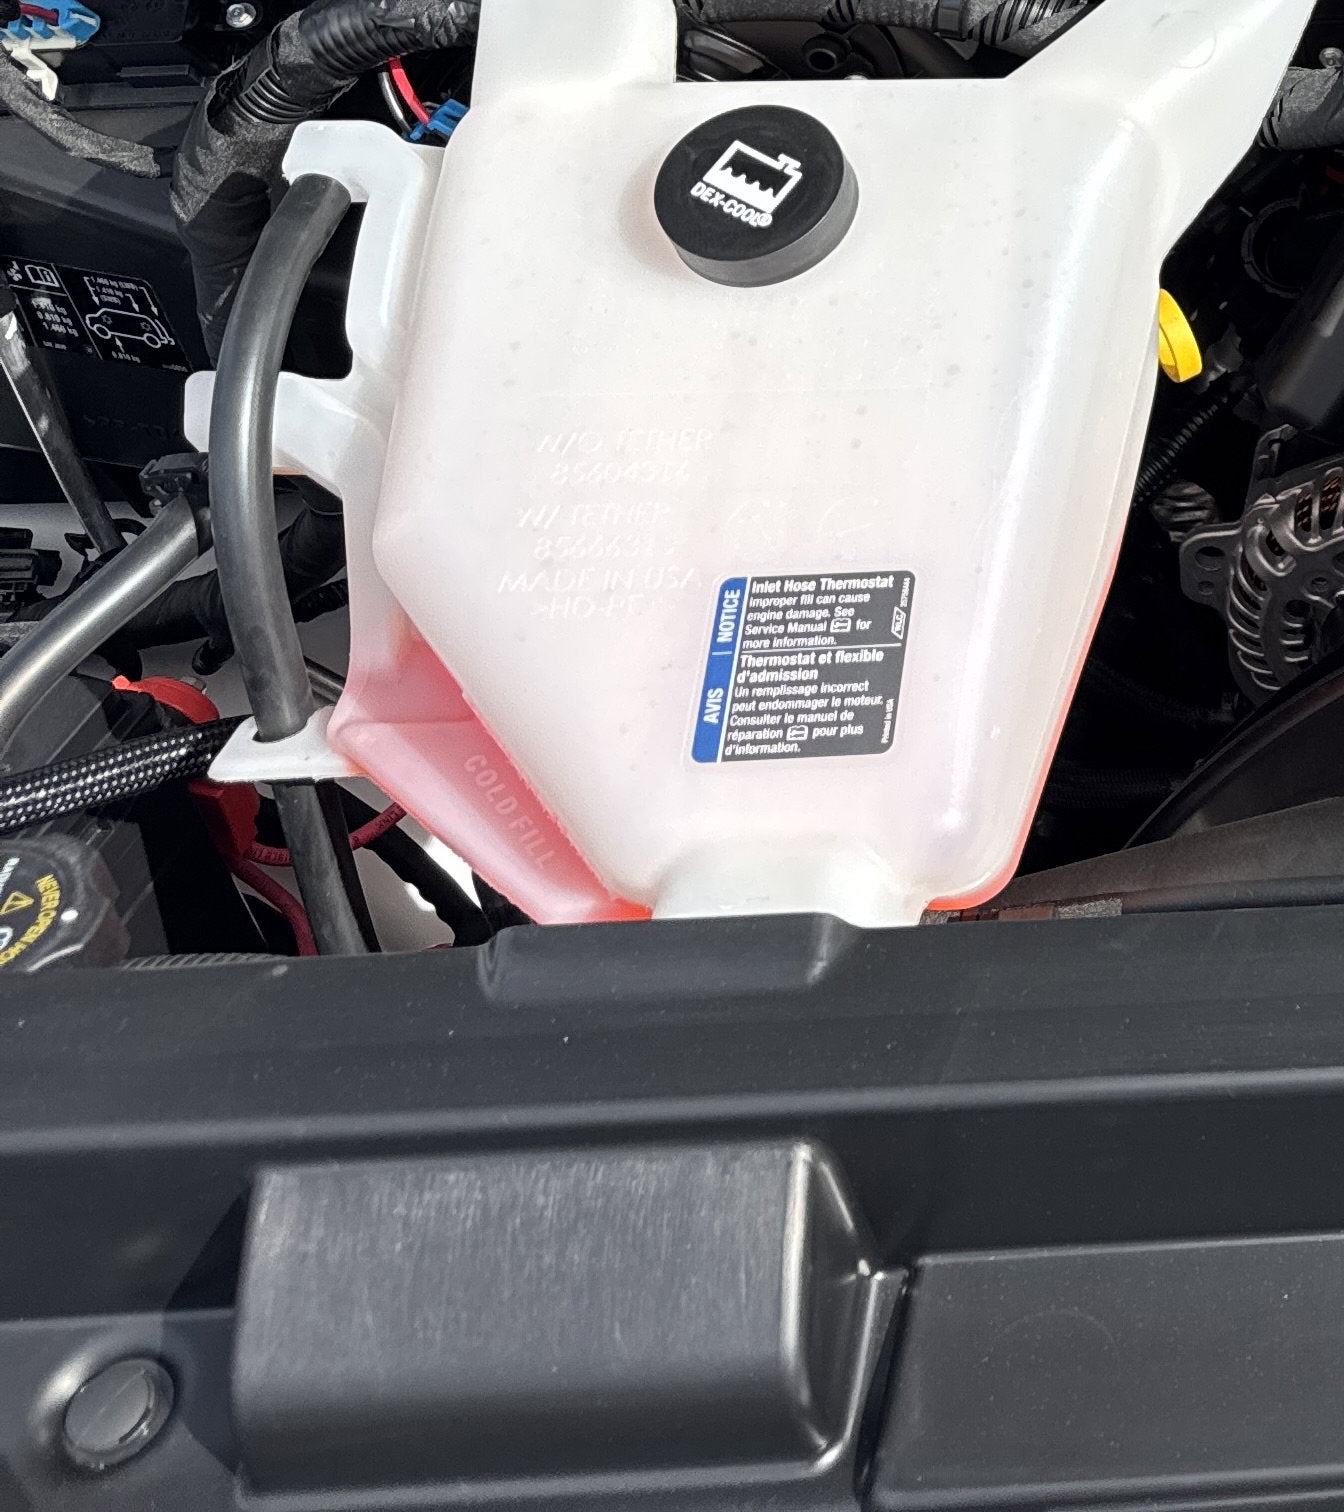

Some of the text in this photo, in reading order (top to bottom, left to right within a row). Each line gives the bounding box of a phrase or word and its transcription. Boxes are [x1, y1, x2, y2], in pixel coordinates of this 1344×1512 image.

[603, 568, 635, 591] IN
[752, 576, 894, 594] Inlet Hose Thermostat
[749, 593, 870, 608] Improper fill can cause
[717, 590, 740, 643] NOTICE
[747, 607, 855, 622] engine damage. See
[745, 619, 872, 635] Service Manual for
[742, 635, 837, 649] more information.
[740, 649, 884, 668] Thermostat et flexible
[737, 668, 819, 683] d'admission
[735, 680, 869, 697] Un remplissage incorrect
[703, 688, 724, 724] AVIS
[732, 695, 883, 712] peut endommager le moteur.
[730, 709, 855, 726] Consulter le manuel de
[812, 727, 838, 738] pour
[840, 724, 864, 735] plus
[725, 741, 801, 756] d'information.
[464, 755, 555, 870] COLD FILL
[35, 873, 61, 909] NEVER
